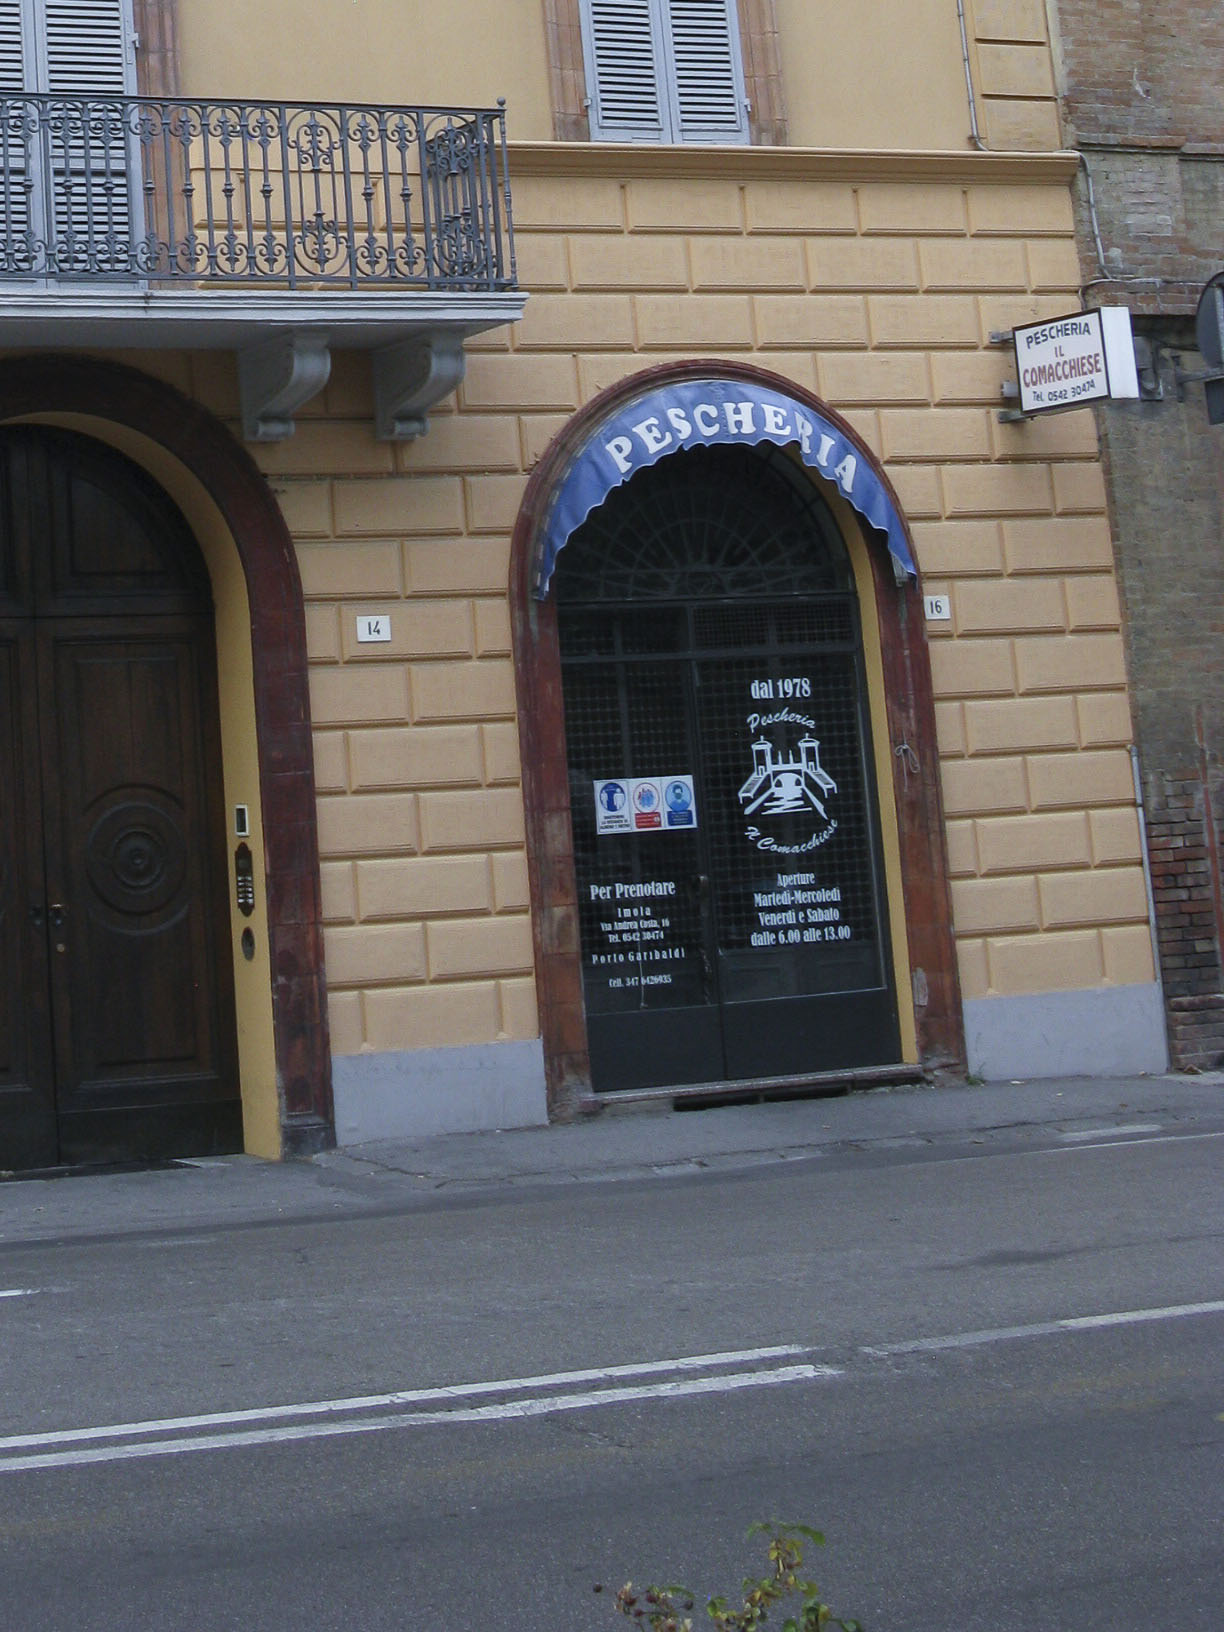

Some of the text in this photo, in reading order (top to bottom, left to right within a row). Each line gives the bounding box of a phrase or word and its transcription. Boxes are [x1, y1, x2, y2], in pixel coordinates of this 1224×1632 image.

[1026, 322, 1091, 349] PESCHERIA
[1054, 345, 1065, 358] IL
[1023, 353, 1102, 388] COMACCHIESE
[1048, 389, 1068, 401] 0542
[1071, 379, 1096, 398] 30474
[605, 401, 857, 494] PESCHERIA
[930, 599, 942, 614] 16
[368, 620, 380, 635] 14
[751, 678, 811, 699] dal 1978
[746, 707, 816, 733] Pescheria
[756, 818, 838, 854] Comacchiese
[777, 872, 816, 888] Aperture
[589, 881, 676, 900] Per Prenotare
[617, 906, 651, 918] Imola
[798, 911, 805, 923] e
[807, 907, 840, 923] Sabato
[750, 925, 851, 946] dalle 6.00 alle 13.00
[592, 947, 685, 965] Porto Garibaldi
